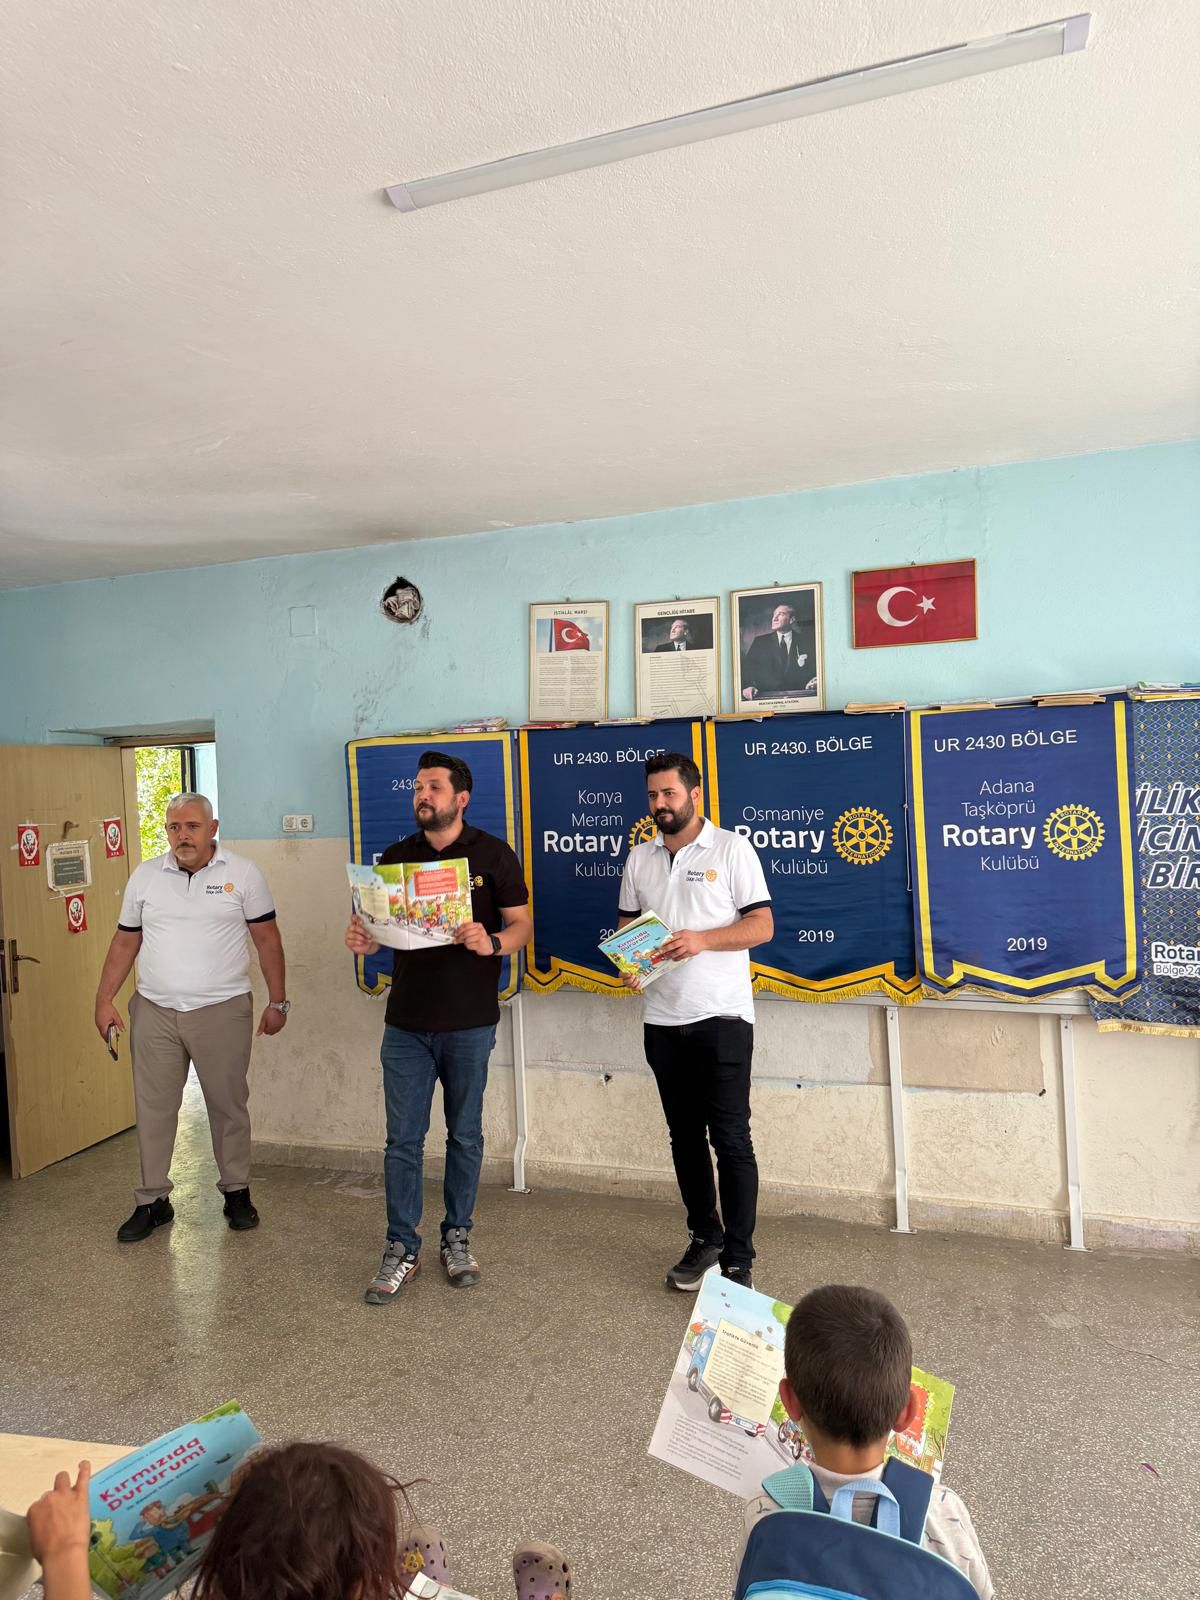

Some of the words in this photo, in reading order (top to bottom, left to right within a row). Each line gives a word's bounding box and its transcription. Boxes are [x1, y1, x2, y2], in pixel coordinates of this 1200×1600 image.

[744, 743, 766, 756] UR
[771, 742, 811, 754] 2430.
[816, 736, 872, 752] BÖLGE
[934, 738, 960, 753] UR
[965, 735, 1006, 750] 2430
[1011, 730, 1078, 748] BÖLGE
[554, 753, 574, 766] UR
[577, 752, 612, 764] 2430.
[980, 780, 1034, 796] Adana
[578, 790, 623, 808] Konya
[1136, 782, 1200, 816] İLİK
[572, 812, 623, 826] Meram
[742, 806, 824, 825] Osmaniye
[848, 812, 874, 820] ROTARY
[961, 800, 1036, 820] Taşköprü
[543, 830, 623, 857] Rotary
[942, 824, 1036, 850] Rotary
[771, 858, 828, 875] Kulübü
[980, 854, 1040, 871] Kulübü
[798, 930, 834, 944] 2019
[1007, 937, 1048, 952] 2019
[1156, 964, 1184, 976] Bölge
[99, 1438, 200, 1503] Kırmızıda
[108, 1446, 207, 1512] Dururum!
